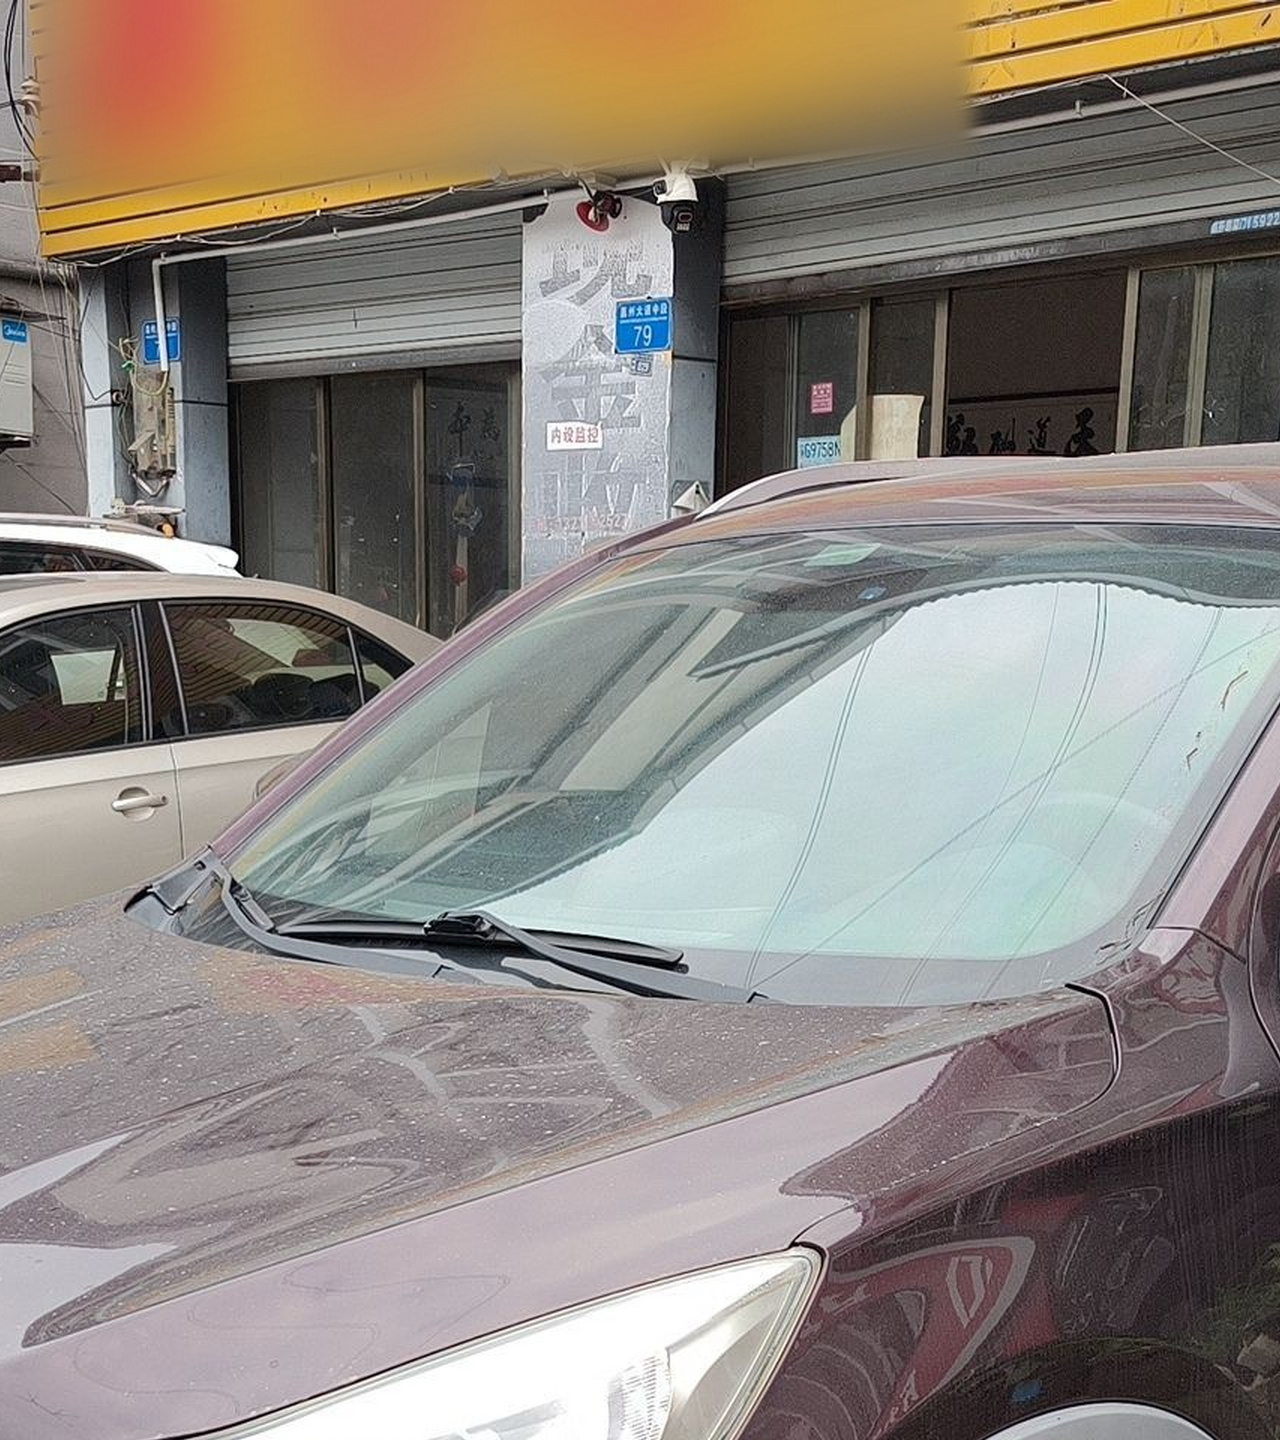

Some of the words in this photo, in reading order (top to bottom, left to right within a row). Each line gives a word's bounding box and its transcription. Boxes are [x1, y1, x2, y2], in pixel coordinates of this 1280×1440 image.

[633, 324, 653, 347] 79
[551, 426, 599, 444] 内设监控
